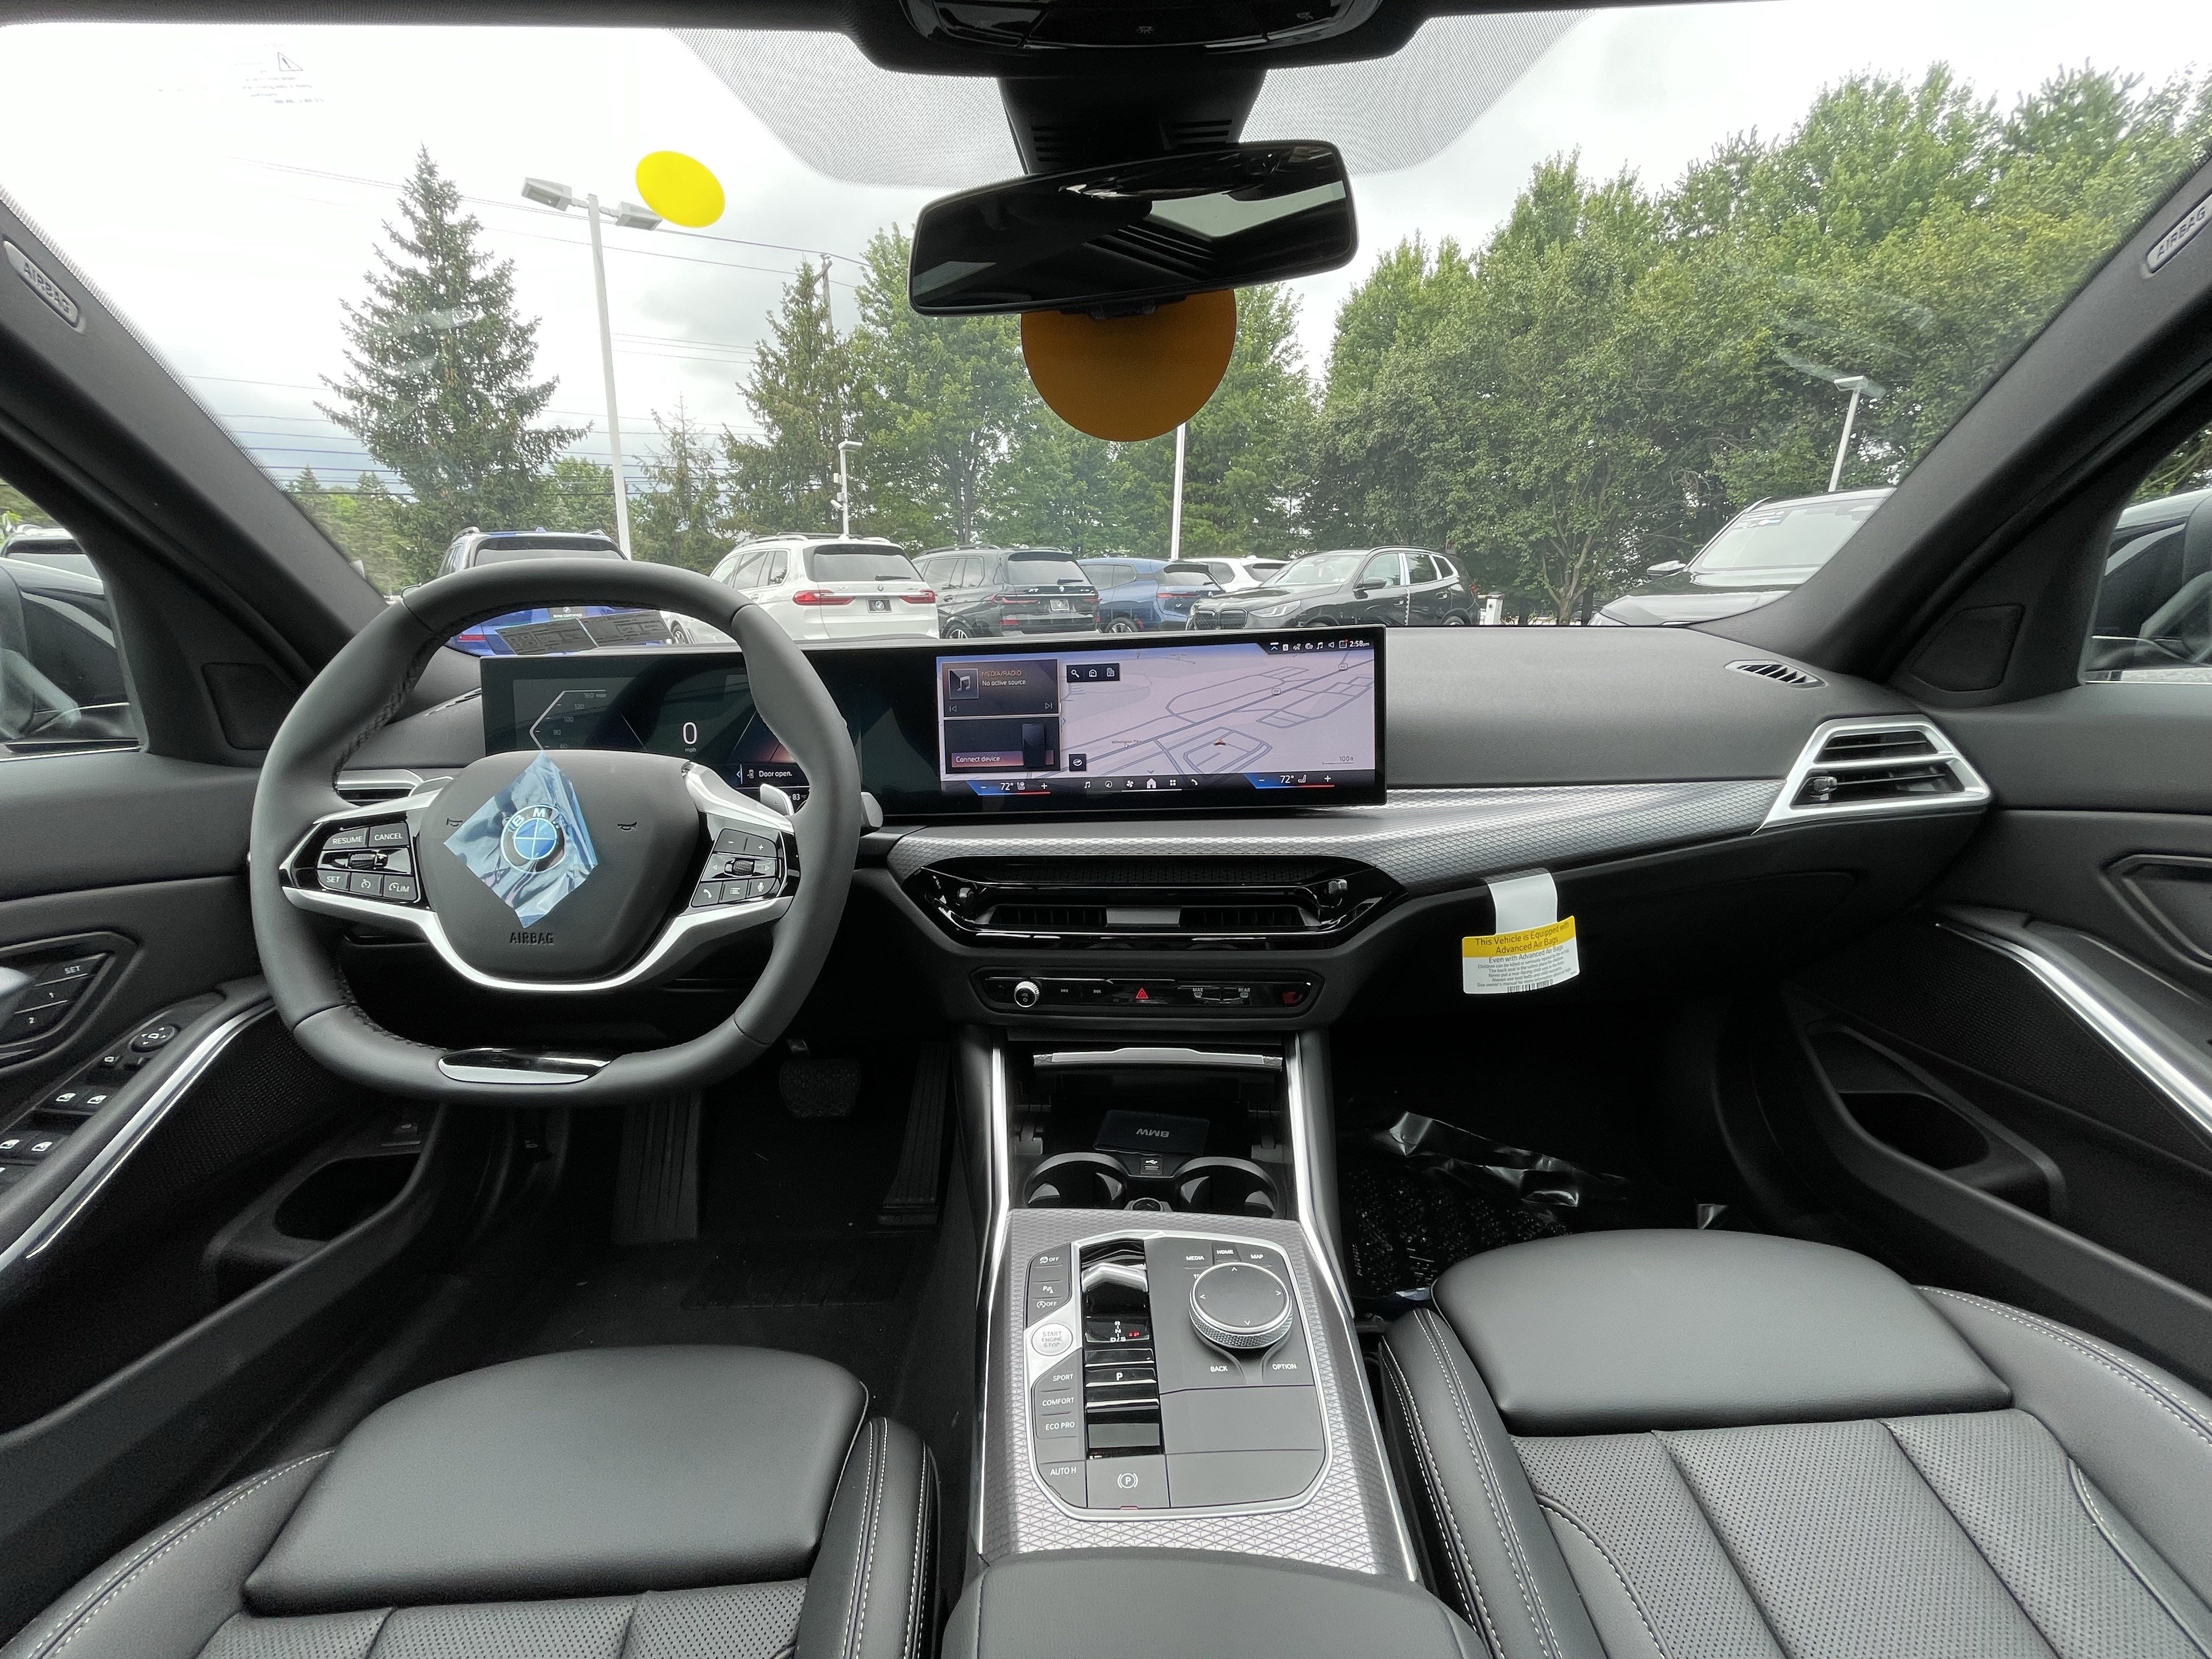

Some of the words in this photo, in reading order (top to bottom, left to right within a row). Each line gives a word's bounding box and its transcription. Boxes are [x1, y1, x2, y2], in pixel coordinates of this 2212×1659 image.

[981, 669, 1023, 678] MEDIA/RADIO
[682, 721, 697, 744] 0
[1280, 775, 1294, 783] 72°
[1000, 782, 1014, 791] 72°
[332, 836, 363, 845] RESUME
[374, 832, 403, 842] CANCEL
[510, 932, 554, 944] AIRBAG
[1475, 938, 1492, 946] This
[1494, 934, 1521, 945] Vehicle
[1523, 932, 1530, 940] is
[1531, 924, 1559, 940] Equipped
[1559, 921, 1570, 931] with
[1496, 941, 1532, 954] Advanced
[1533, 940, 1543, 949] Air
[1544, 936, 1559, 946] Bags
[1519, 949, 1545, 960] Advanced
[1553, 944, 1564, 952] Bags
[64, 965, 81, 974] SET
[1136, 1128, 1170, 1137] BMW
[1052, 1373, 1074, 1382] SPORT
[1116, 1372, 1124, 1381] P
[1042, 1397, 1075, 1407] COMFORT
[1045, 1423, 1060, 1431] ECO
[1060, 1421, 1075, 1429] PRO
[1049, 1467, 1070, 1476] AUTO
[1071, 1466, 1077, 1474] H
